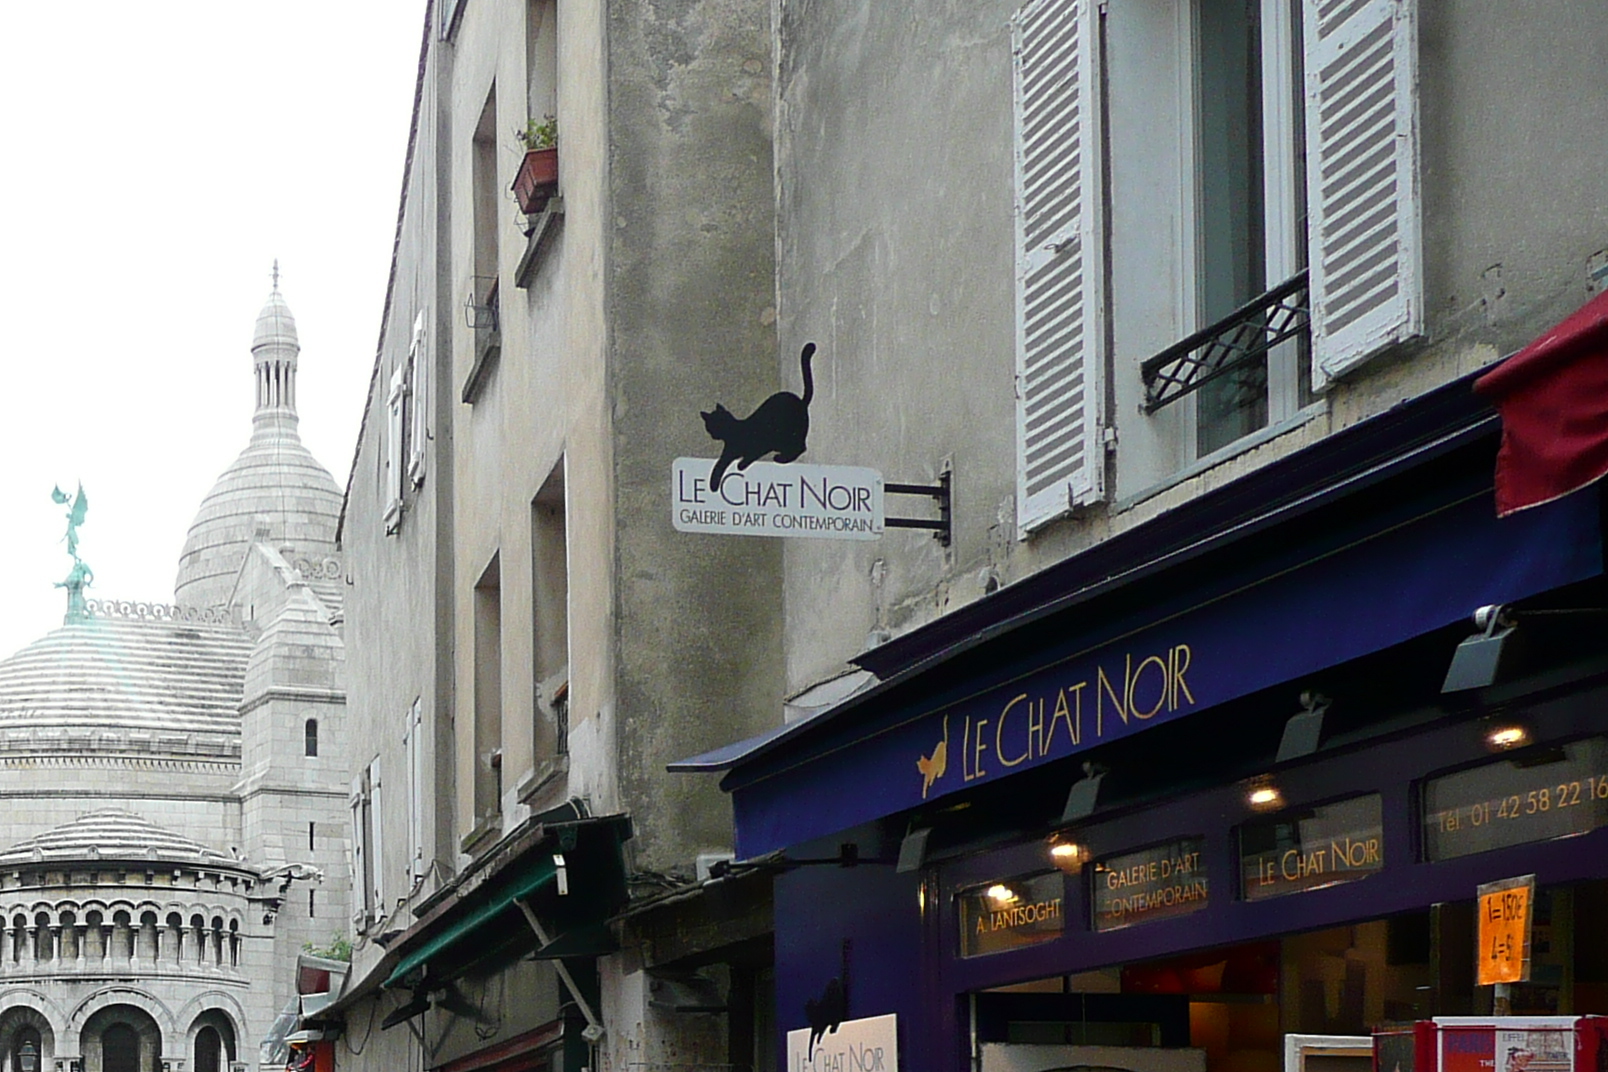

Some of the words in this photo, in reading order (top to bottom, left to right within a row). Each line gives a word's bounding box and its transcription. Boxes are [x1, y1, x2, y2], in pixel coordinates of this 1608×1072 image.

[679, 469, 706, 504] LE
[720, 472, 792, 508] CHAT
[800, 475, 873, 513] NOIR
[679, 509, 726, 526] GALERIE
[732, 511, 767, 527] D'ART
[773, 514, 873, 532] CONTEMPORAIN
[962, 715, 988, 782] LE
[996, 681, 1087, 767] CHAT
[1097, 643, 1196, 738] NOIR
[1471, 803, 1490, 826] 01
[1497, 795, 1520, 820] 42
[1526, 788, 1550, 814] 58
[1557, 783, 1581, 809] 22
[1107, 861, 1157, 890] GALERIE
[1161, 852, 1200, 877] D'ART
[1258, 856, 1275, 887] LE
[1281, 849, 1326, 881] CHAT
[1331, 837, 1381, 872] NOIR
[991, 898, 1061, 932] LANTSOGHT
[1480, 1059, 1495, 1067] THE
